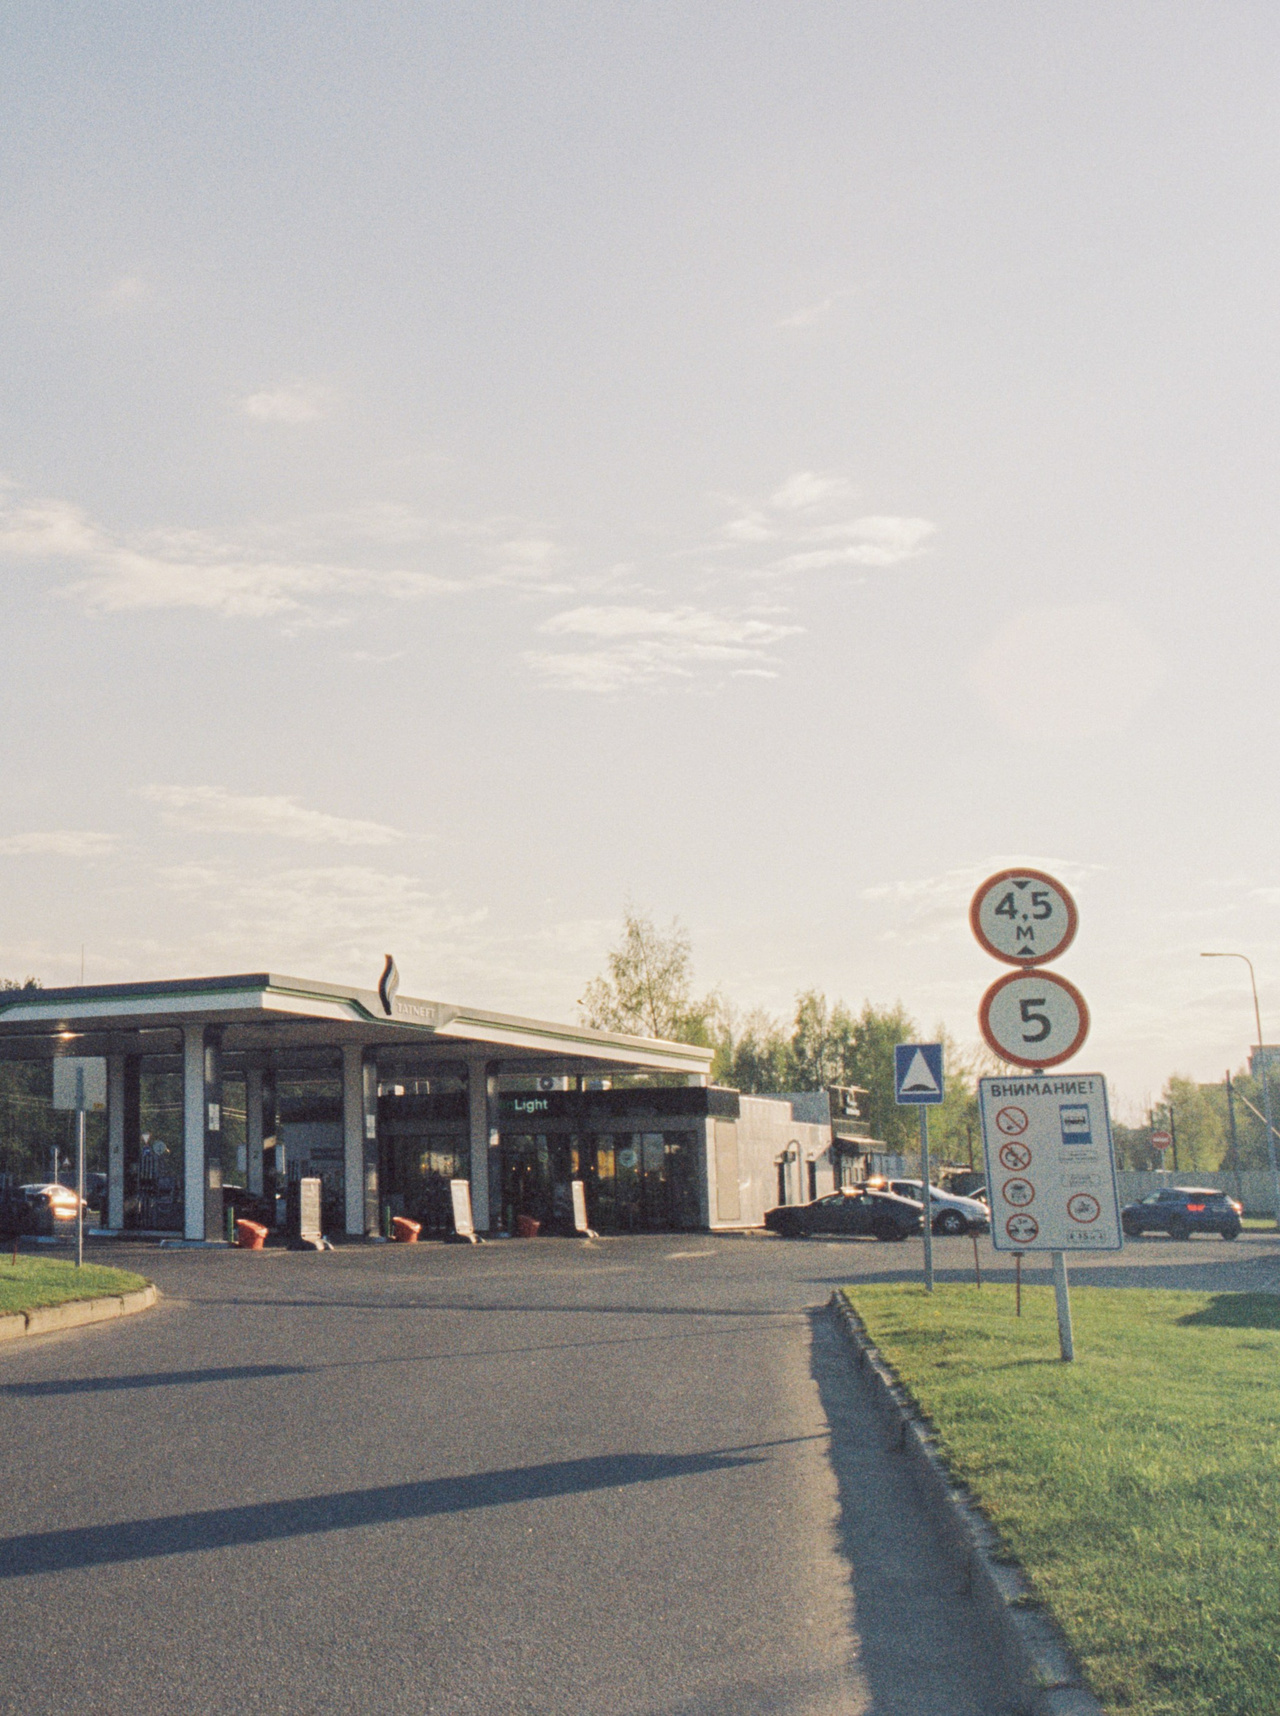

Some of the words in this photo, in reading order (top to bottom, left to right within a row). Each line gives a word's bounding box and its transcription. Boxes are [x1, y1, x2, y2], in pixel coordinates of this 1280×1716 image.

[396, 1002, 436, 1018] TATNEFT
[1019, 998, 1052, 1043] 5
[990, 1081, 1094, 1098] ВНИМАНИЕ!
